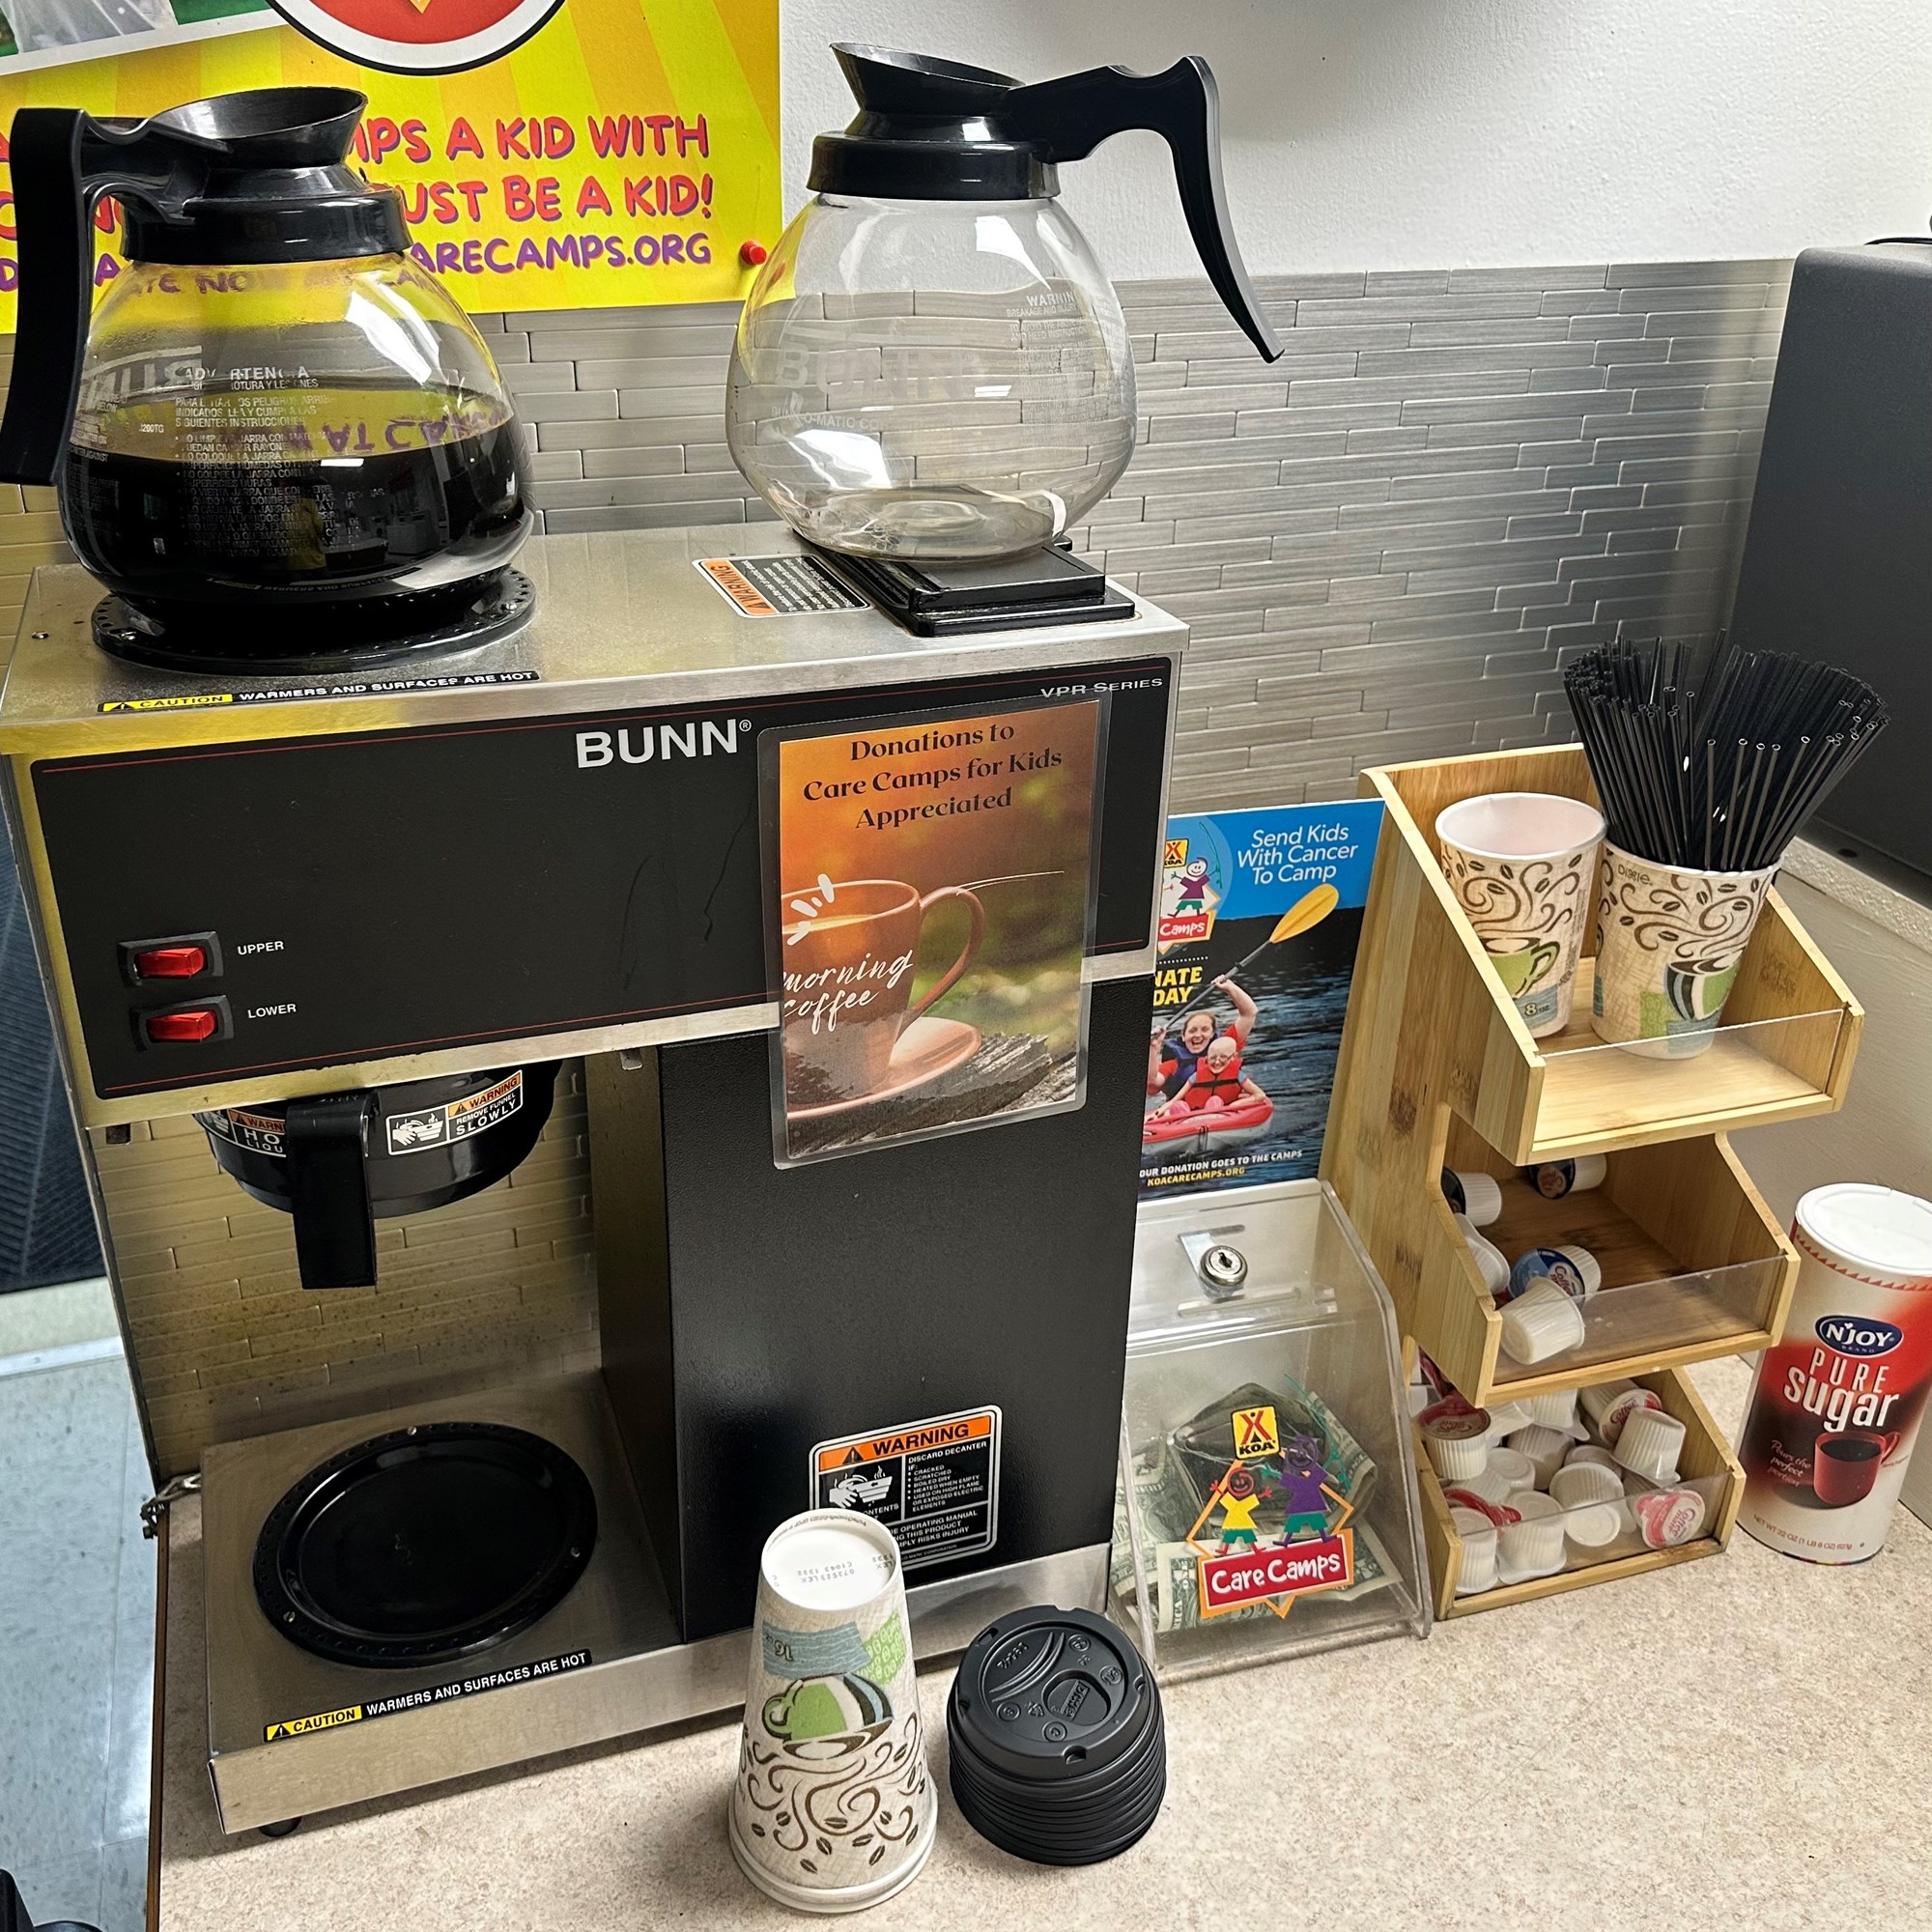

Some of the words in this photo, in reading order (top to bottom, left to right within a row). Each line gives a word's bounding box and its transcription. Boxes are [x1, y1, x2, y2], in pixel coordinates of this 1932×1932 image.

[446, 117, 484, 161] A
[496, 116, 575, 159] KID
[588, 114, 709, 157] WITH
[396, 181, 487, 224] UST
[501, 175, 562, 222] BE
[577, 176, 611, 217] A
[625, 173, 714, 218] KID!
[410, 233, 711, 274] ARECAMPS.ORG
[1027, 291, 1075, 306] WARNIN
[710, 565, 761, 609] WARNING
[140, 695, 224, 708] CAUTION
[240, 688, 327, 701] WARMERS
[331, 684, 366, 695] AND
[464, 675, 496, 684] ARE
[500, 672, 532, 681] HOT
[1040, 685, 1088, 698] VPR
[850, 730, 983, 762] Donations
[989, 724, 1014, 743] to
[803, 777, 867, 802] Care
[871, 765, 961, 795] Camps
[967, 757, 1004, 780] for
[1009, 750, 1063, 774] Kids
[855, 787, 1012, 830] Appreciated
[1251, 827, 1302, 848] Send
[1307, 823, 1349, 842] Kids
[1237, 845, 1283, 867] With
[1288, 843, 1359, 865] Cancer
[1253, 867, 1274, 885] To
[1278, 865, 1337, 883] Camp
[1160, 921, 1206, 938] Camps
[238, 941, 284, 955] UPPER
[782, 950, 914, 993] morning
[247, 1003, 297, 1019] LOWER
[782, 989, 879, 1035] coffee
[1524, 1002, 1538, 1017] 8
[469, 1077, 517, 1107] WARNING
[456, 1098, 516, 1135] SLOWLY
[457, 1108, 489, 1124] REMOVE
[490, 1092, 516, 1111] FUNNEL
[247, 1118, 286, 1131] WARN
[243, 1127, 280, 1145] HO
[246, 1139, 284, 1153] LIQU
[1161, 1160, 1209, 1175] DONATION
[1211, 1157, 1236, 1169] GOES
[1237, 1155, 1249, 1164] TO
[1251, 1152, 1269, 1163] THE
[1271, 1149, 1303, 1160] CAMPS
[1147, 1166, 1246, 1186] KOACARECAMPS.ORG
[1809, 1348, 1890, 1393] PURE
[1783, 1366, 1900, 1433] sugar
[872, 1423, 969, 1456] WARNING
[1239, 1440, 1275, 1456] KOA
[908, 1450, 943, 1463] DISCARD
[945, 1440, 987, 1456] DECANTER
[1795, 1455, 1811, 1469] the
[914, 1464, 945, 1475] CRACKED
[914, 1469, 952, 1482] SCRATCHED
[1768, 1466, 1800, 1488] portion
[1770, 1457, 1804, 1478] perfect
[914, 1479, 937, 1488] BOILED
[914, 1484, 938, 1494] HEATED
[939, 1480, 957, 1489] WHEN
[958, 1474, 980, 1484] EMPTY
[914, 1491, 930, 1500] USED
[959, 1481, 980, 1490] FLAME
[923, 1492, 952, 1504] EXPOSED
[953, 1485, 983, 1496] ELECTRIC
[864, 1503, 899, 1516] ONTENTS
[913, 1500, 946, 1512] ELEMENTS
[900, 1517, 945, 1533] OPERATING
[946, 1510, 978, 1521] MANUAL
[906, 1527, 923, 1538] THIS
[924, 1520, 961, 1534] PRODUCT
[1753, 1514, 1766, 1528] NET
[1766, 1523, 1778, 1534] WT
[1787, 1532, 1799, 1543] OZ
[918, 1533, 940, 1544] RISKS
[942, 1526, 970, 1538] INJURY
[1210, 1567, 1264, 1594] Care
[1267, 1551, 1342, 1583] Camps
[293, 1709, 355, 1732] CAUTION
[366, 1690, 432, 1717] WARMERS
[435, 1684, 461, 1699] AND
[464, 1666, 530, 1692] SURFACES
[533, 1660, 558, 1675] ARE
[561, 1652, 586, 1668] HOT
